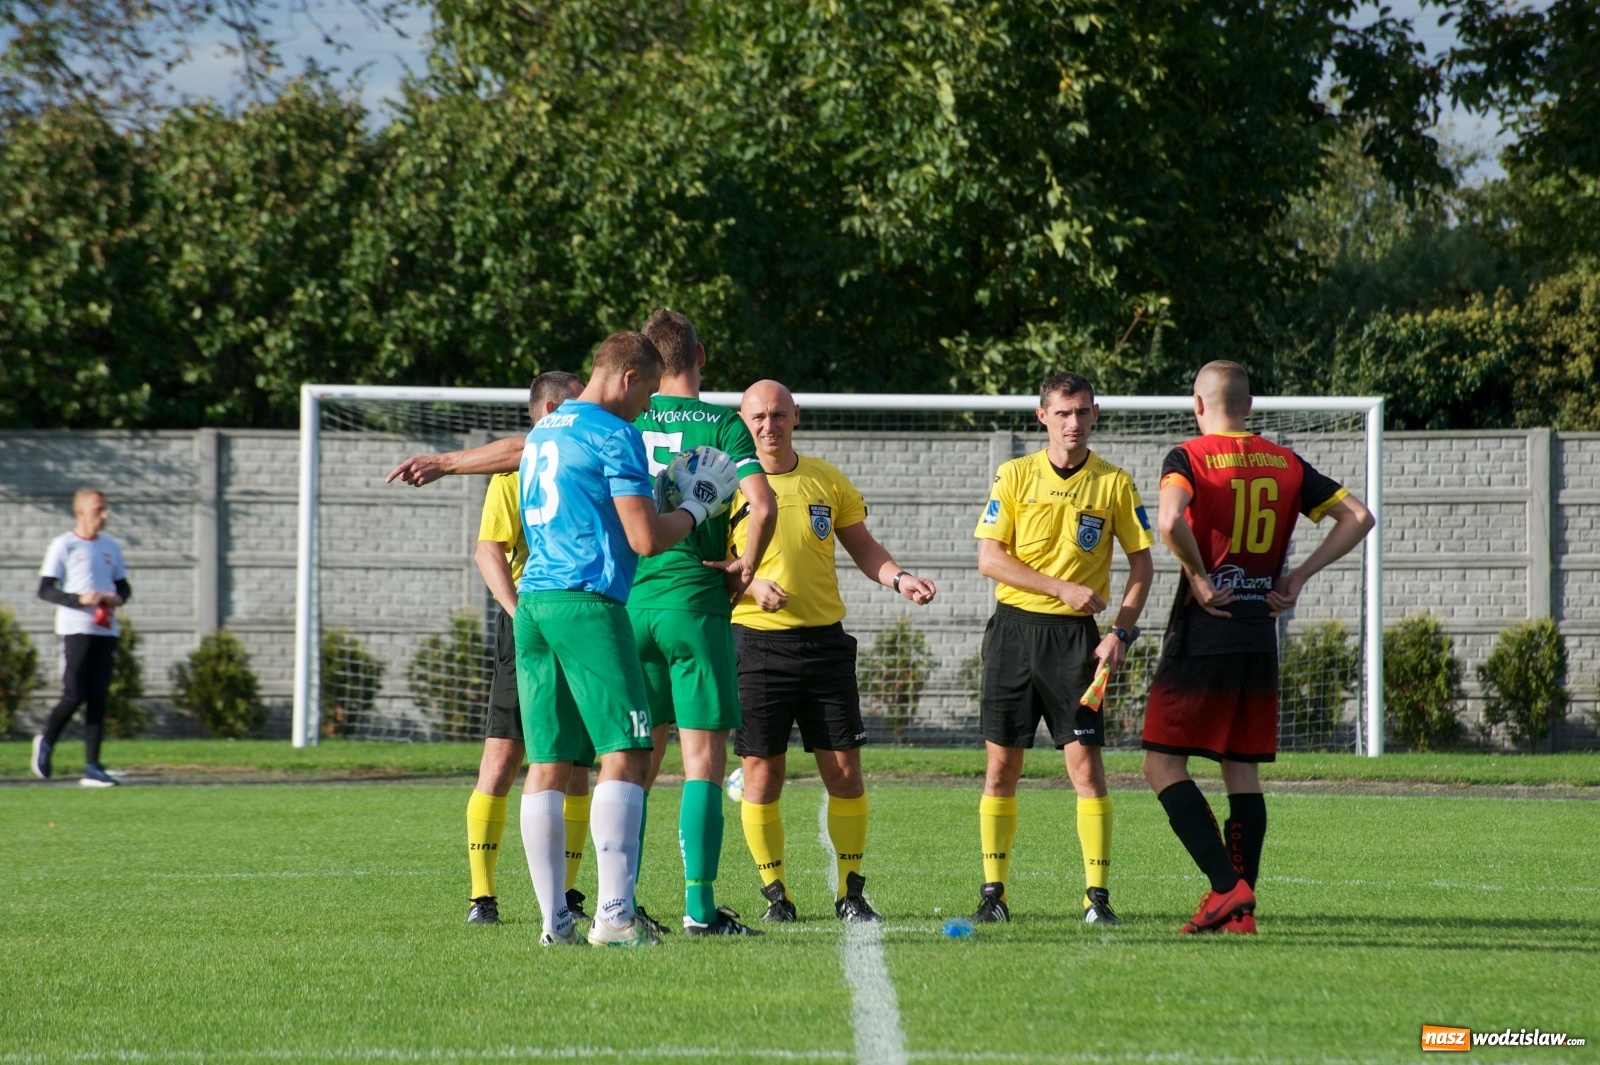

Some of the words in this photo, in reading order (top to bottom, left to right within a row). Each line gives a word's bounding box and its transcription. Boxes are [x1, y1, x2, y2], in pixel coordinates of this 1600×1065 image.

[519, 440, 559, 526] 23
[1229, 477, 1279, 554] 16
[629, 711, 650, 738] 12
